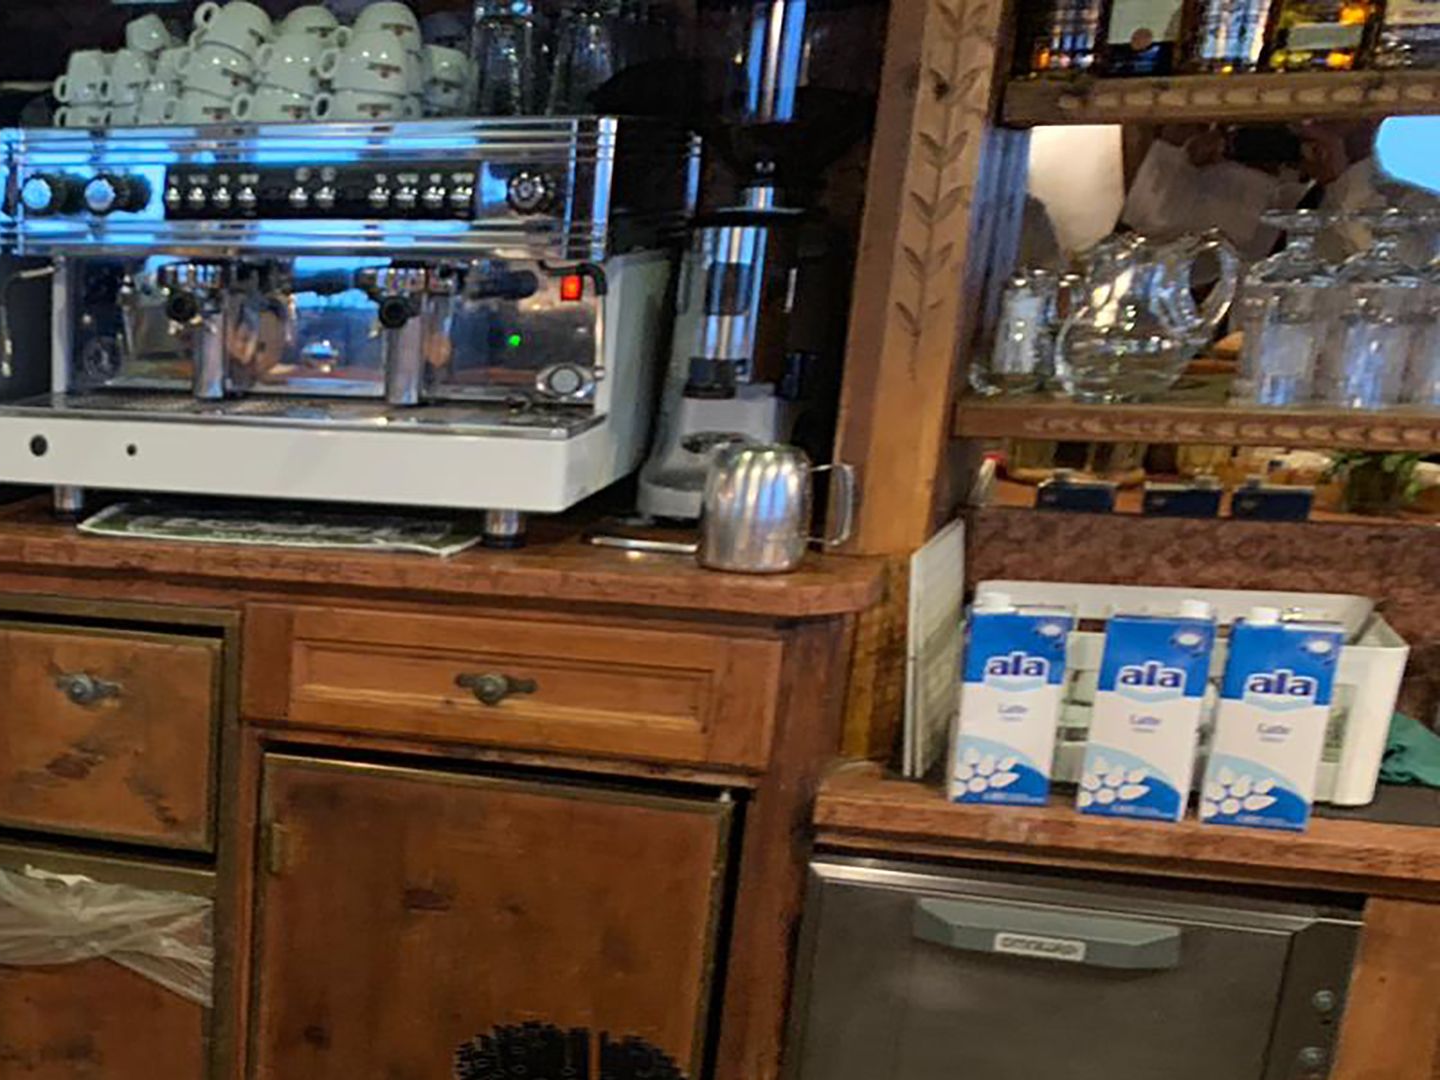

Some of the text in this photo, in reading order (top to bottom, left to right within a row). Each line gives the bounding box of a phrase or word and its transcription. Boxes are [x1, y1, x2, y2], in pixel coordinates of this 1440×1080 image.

[989, 655, 1045, 677] ala
[1120, 664, 1182, 688] ala
[1249, 672, 1312, 697] ala
